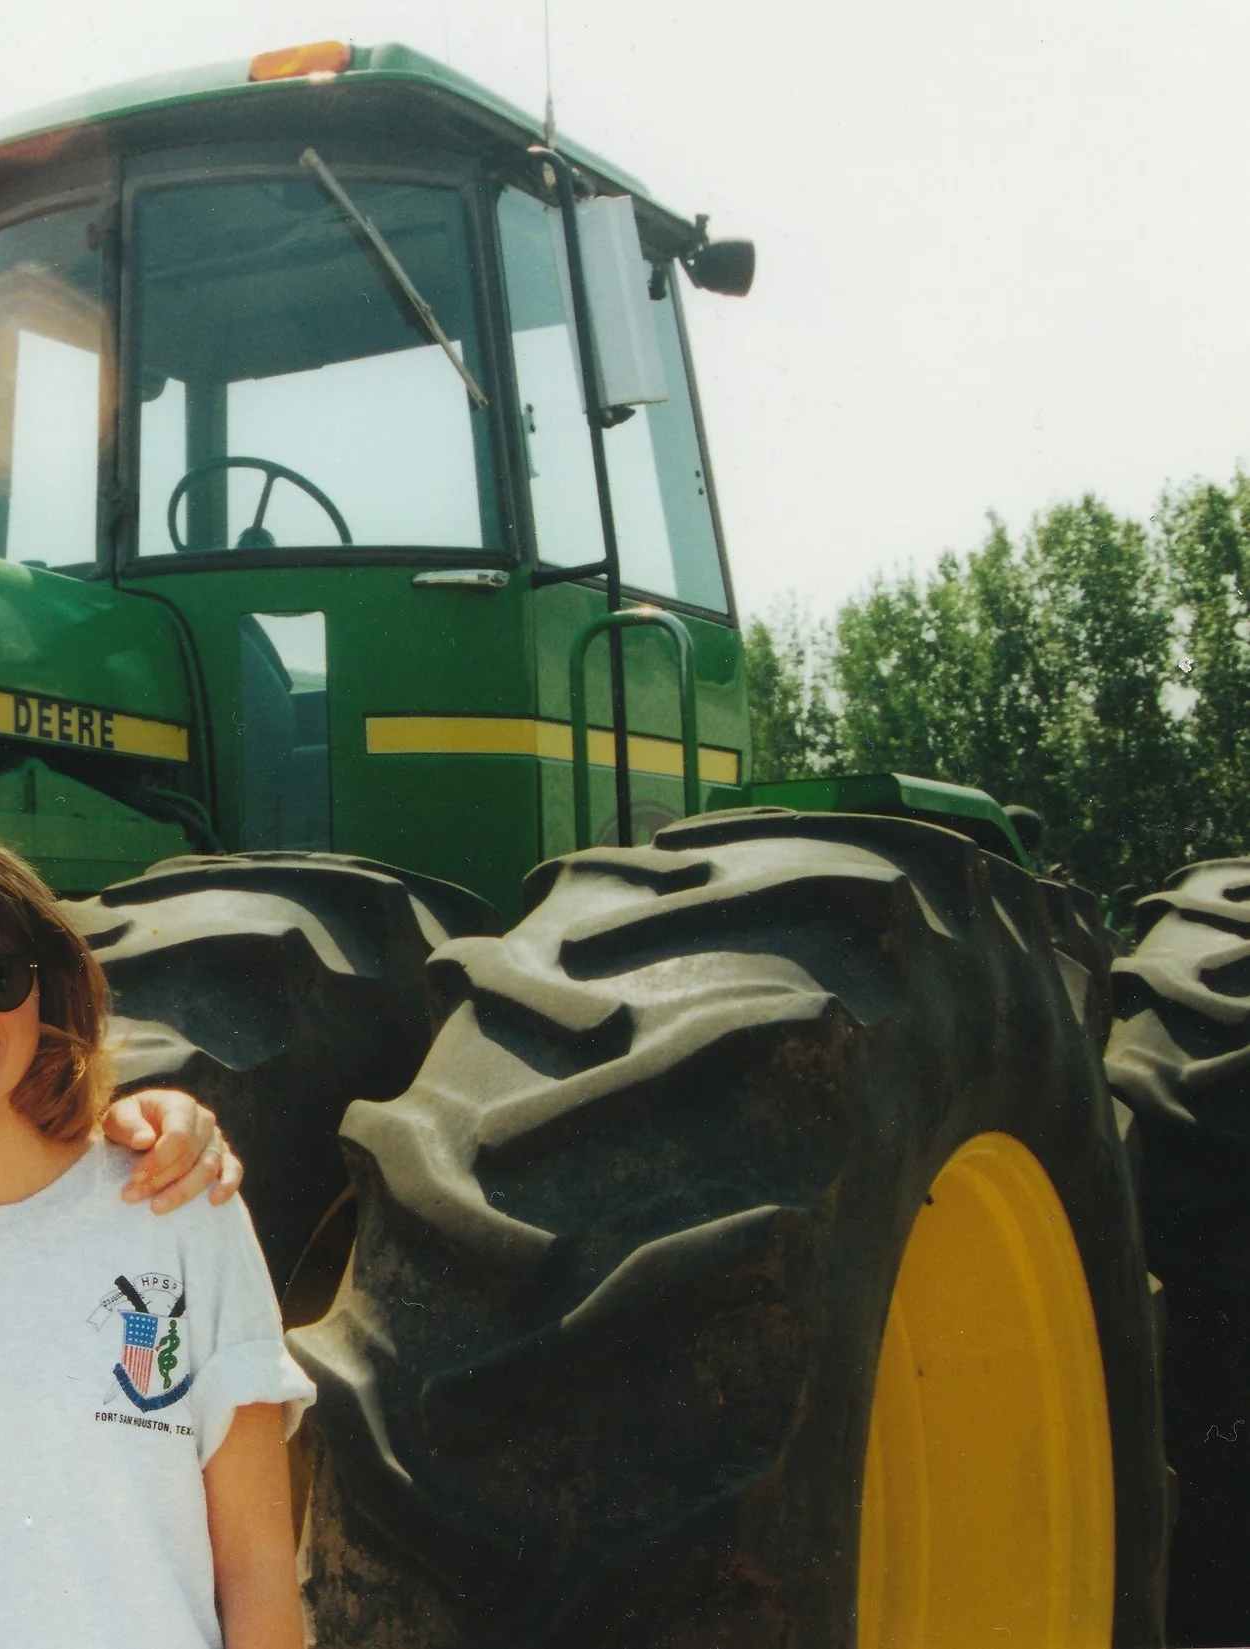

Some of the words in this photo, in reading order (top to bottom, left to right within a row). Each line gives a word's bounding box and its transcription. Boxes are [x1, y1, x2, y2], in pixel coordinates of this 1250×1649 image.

[13, 695, 115, 749] DEERE
[95, 1412, 118, 1422] FORT
[119, 1414, 133, 1425] SAM
[176, 1425, 194, 1436] TEX
